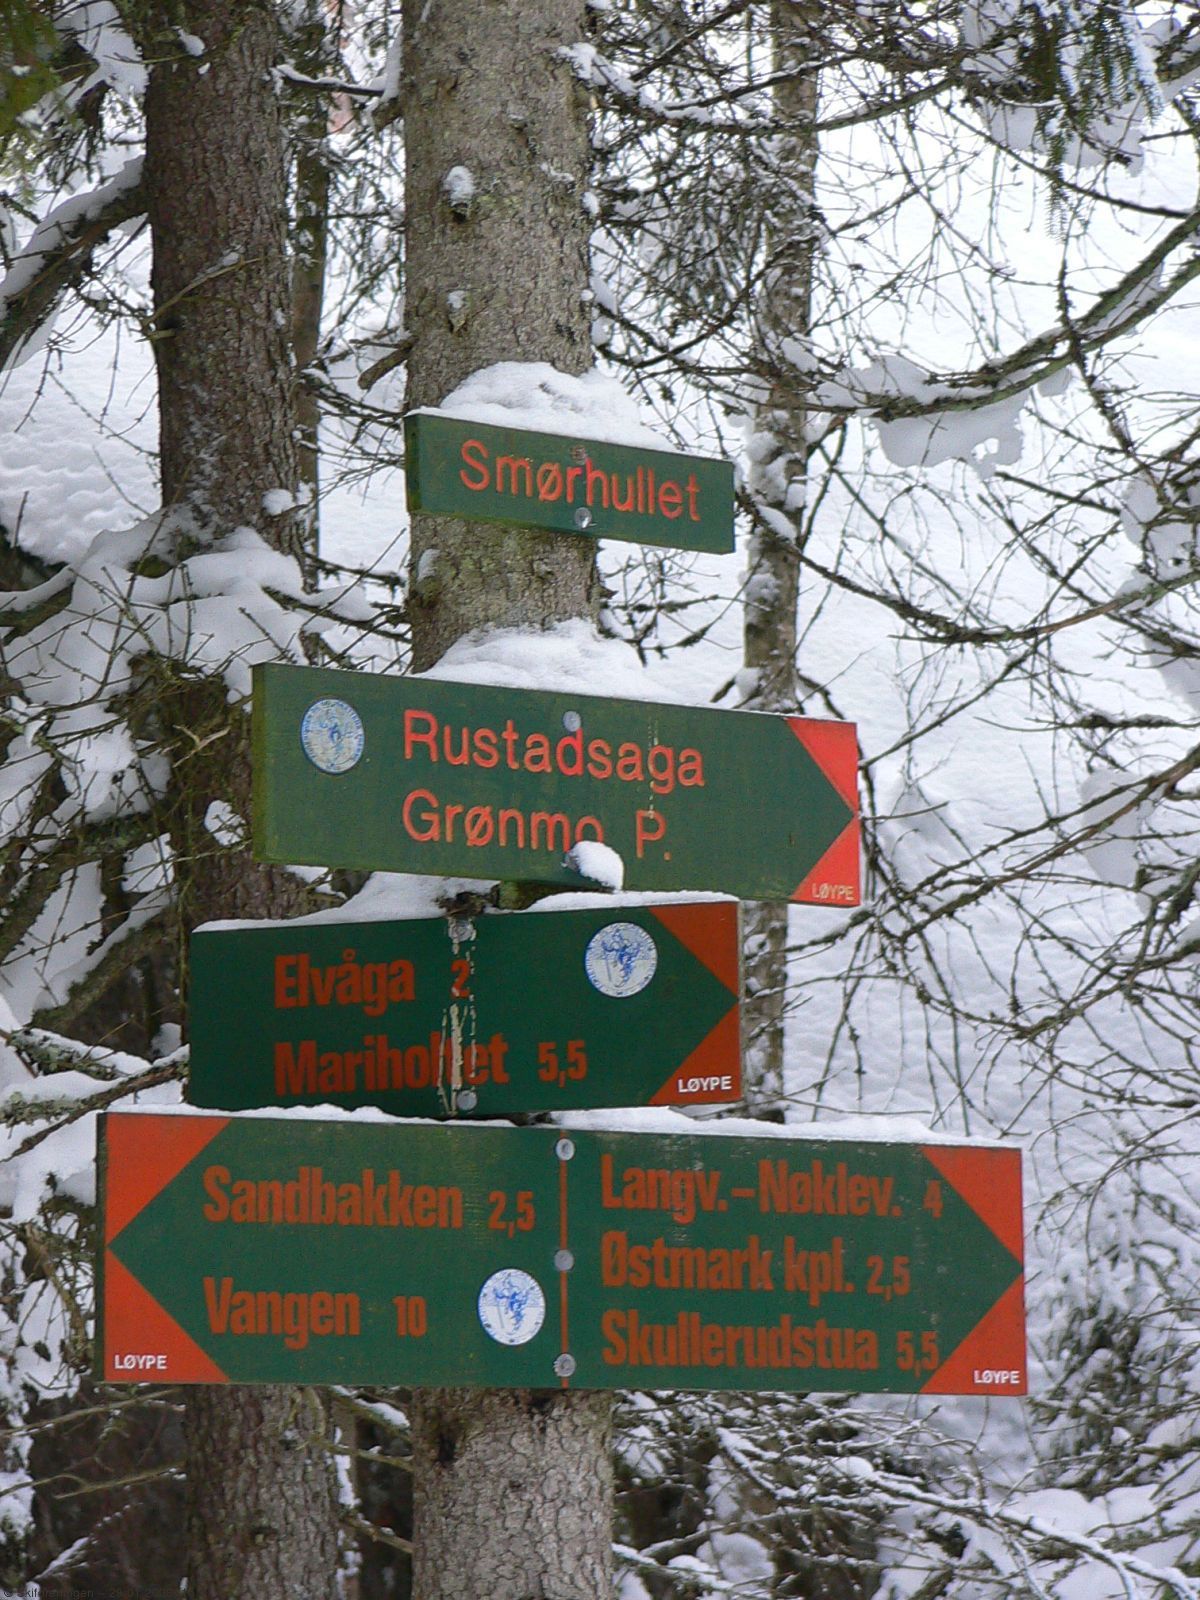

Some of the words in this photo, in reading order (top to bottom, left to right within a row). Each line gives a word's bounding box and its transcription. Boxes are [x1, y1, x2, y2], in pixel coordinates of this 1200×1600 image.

[459, 439, 700, 521] Smørhullet
[403, 709, 704, 794] Rustadsaga
[402, 789, 604, 853] Grønmo
[635, 809, 672, 861] P.
[812, 882, 855, 901] LØYPE
[274, 949, 415, 1017] Elvåga
[451, 959, 470, 998] 2
[538, 1040, 588, 1088] 5,5
[677, 1074, 733, 1092] LØYPE
[203, 1165, 463, 1229] Sandbakken
[489, 1191, 535, 1238] 2,5
[924, 1180, 943, 1218] 4
[602, 1231, 773, 1291] Østmark
[784, 1237, 854, 1307] kpl.
[866, 1256, 910, 1301] 2,5
[203, 1277, 360, 1350] Vangen
[394, 1296, 427, 1337] 10
[602, 1309, 878, 1370] Skullerudstua
[897, 1331, 940, 1376] 5,5
[114, 1354, 167, 1370] LØYPE
[974, 1369, 1020, 1384] LØYPE
